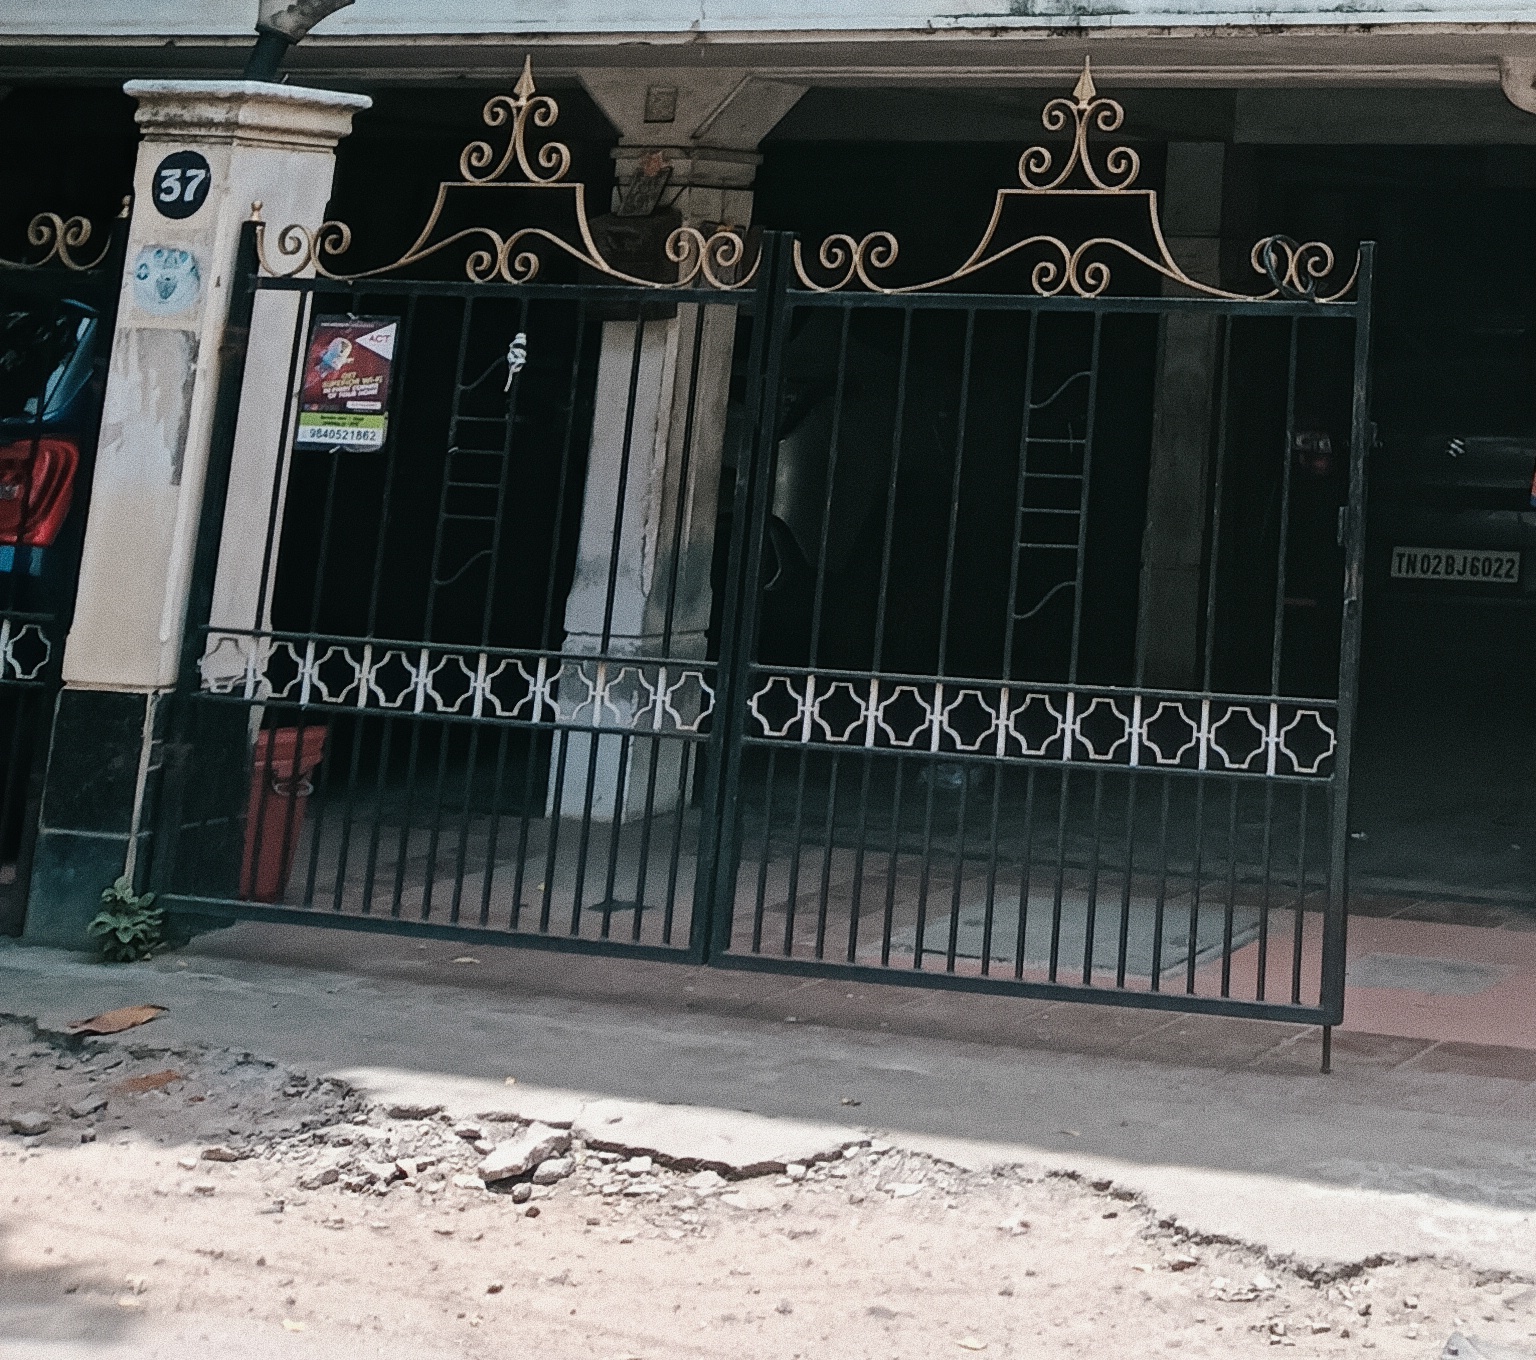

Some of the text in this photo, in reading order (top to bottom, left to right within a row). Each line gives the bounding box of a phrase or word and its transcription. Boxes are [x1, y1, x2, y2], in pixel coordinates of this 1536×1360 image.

[159, 168, 206, 202] 37
[369, 334, 391, 343] ACT
[1396, 552, 1516, 579] TN02BJ6022
